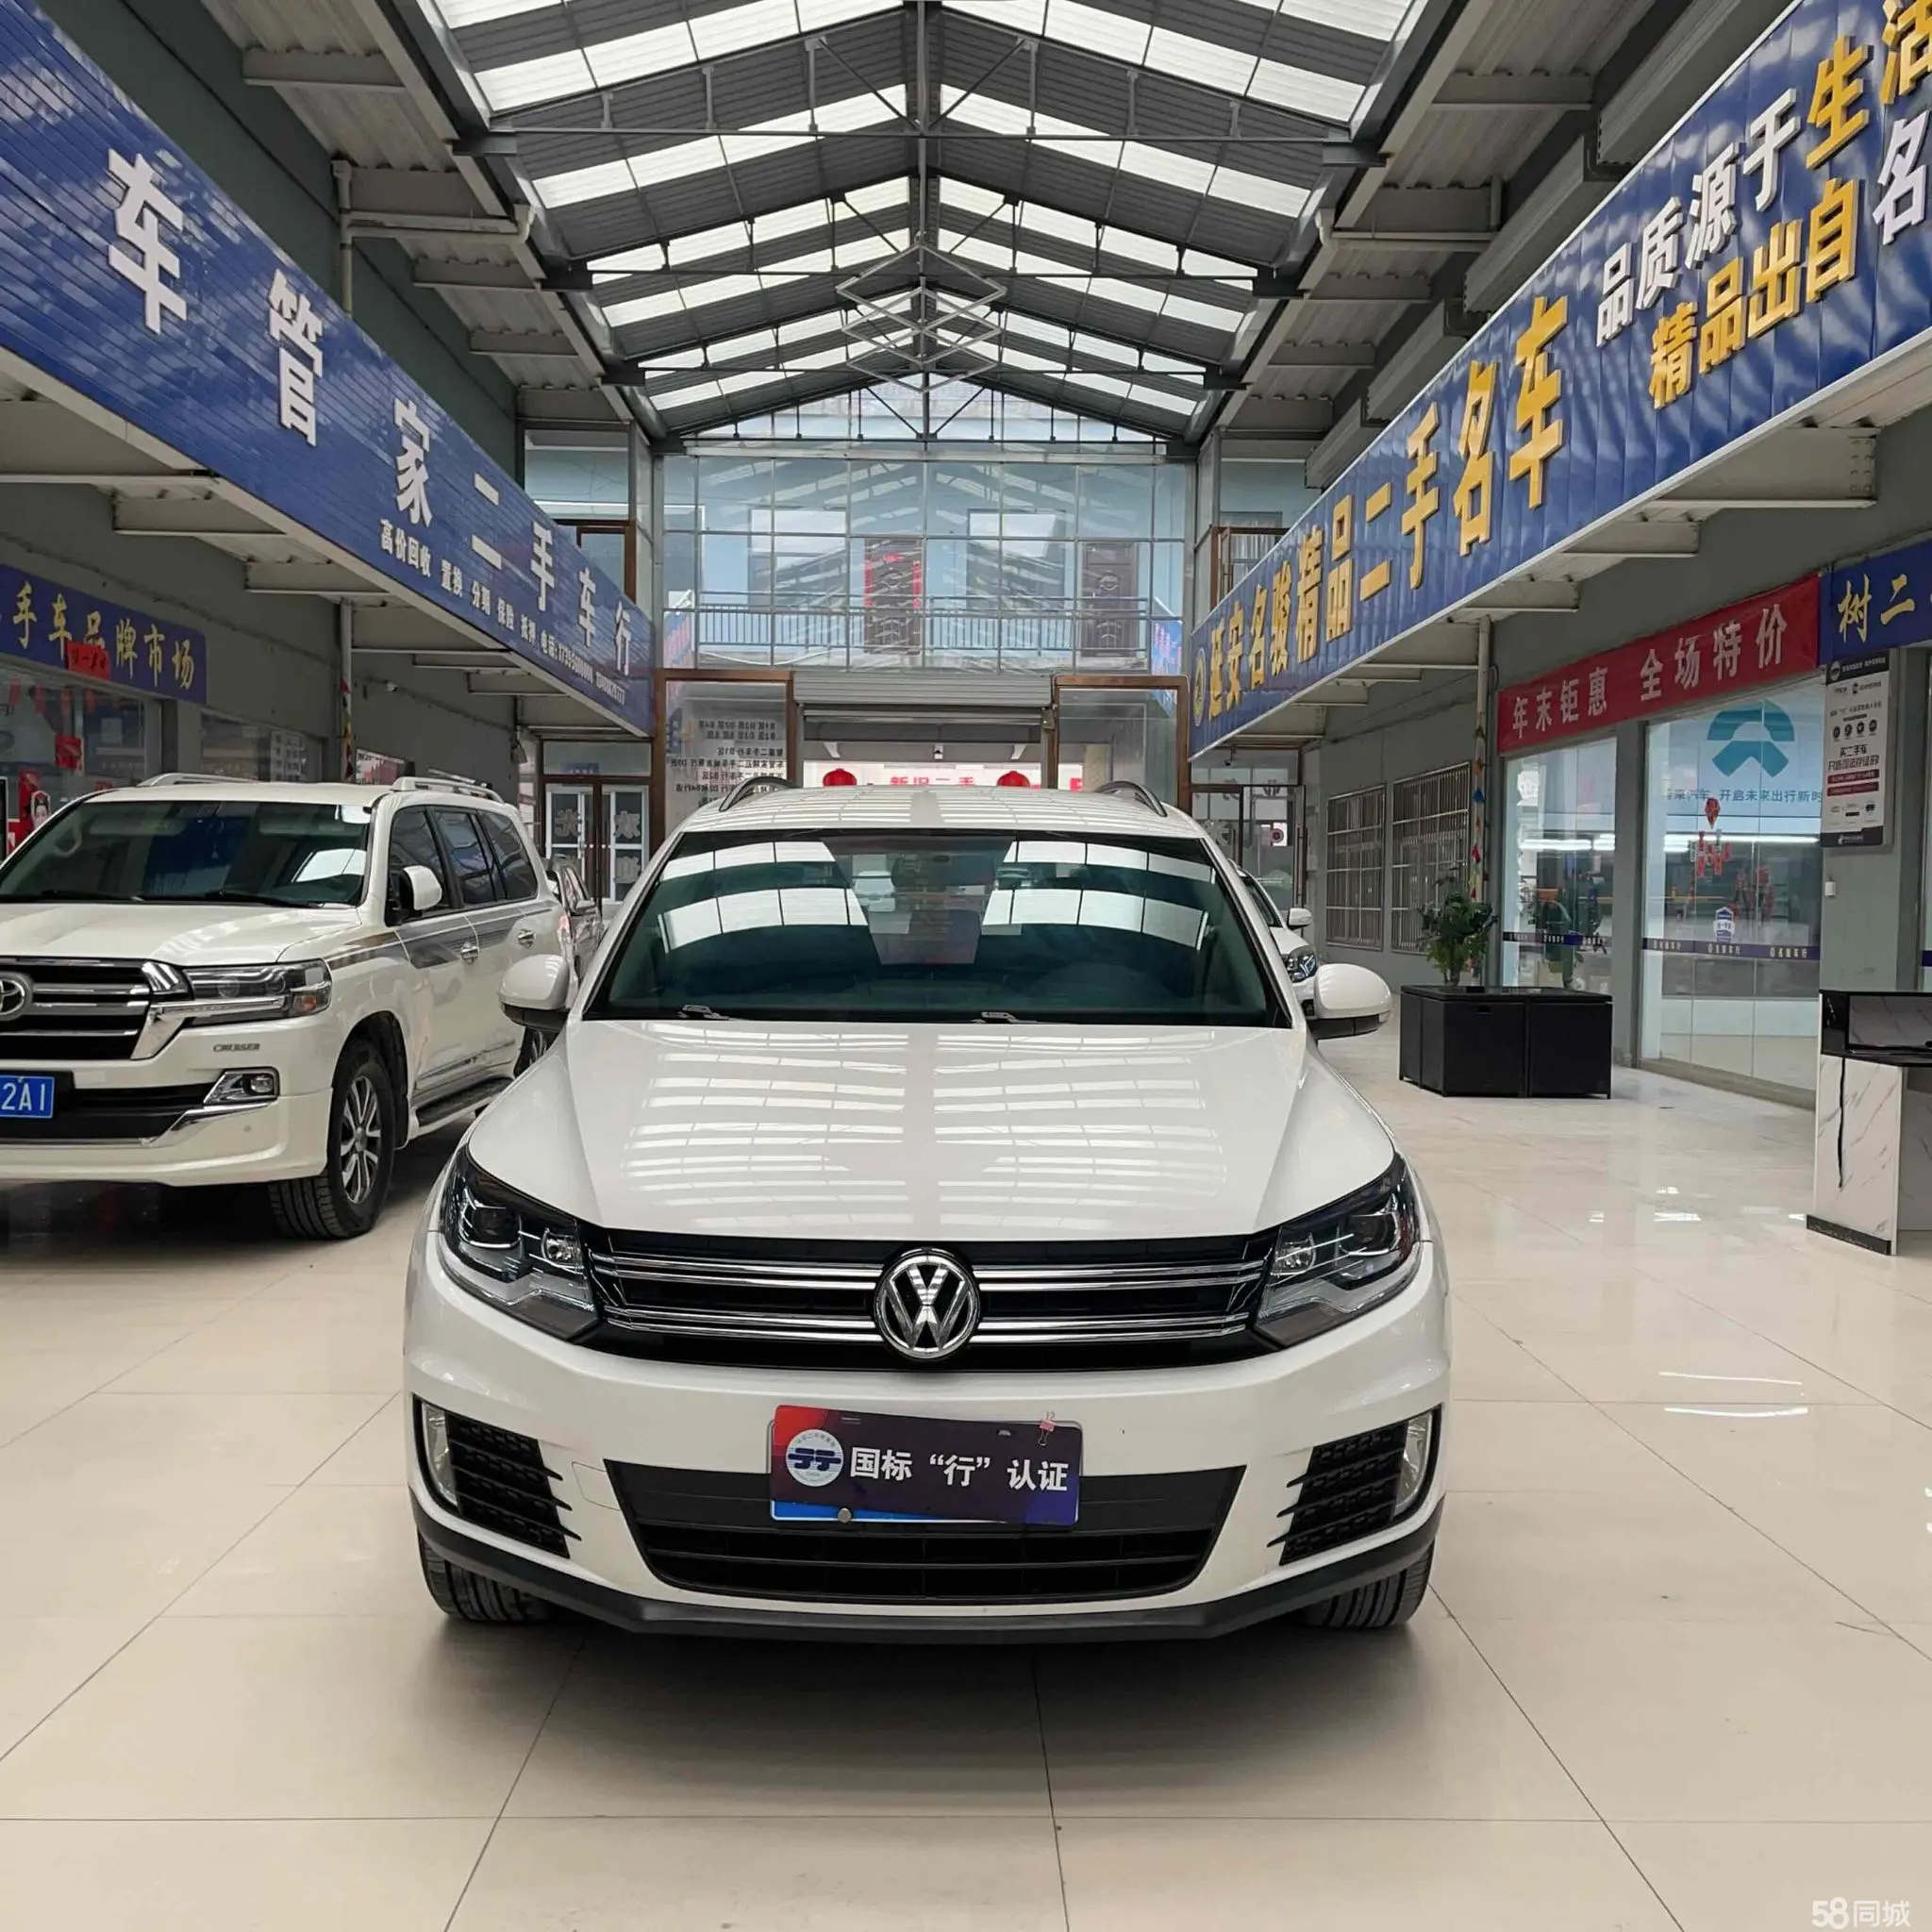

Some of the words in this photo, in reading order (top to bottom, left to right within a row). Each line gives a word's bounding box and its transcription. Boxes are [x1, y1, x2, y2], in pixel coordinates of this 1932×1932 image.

[1649, 110, 1931, 410] 精品出自名
[108, 147, 631, 676] 车管家二手车行
[380, 518, 431, 578] 高价回收
[441, 558, 463, 598] 置换
[1512, 665, 1608, 740] 年末钜惠
[1640, 603, 1789, 702] 全场特价
[1, 1082, 46, 1111] 2A1
[850, 1447, 913, 1481] 国标
[1007, 1460, 1069, 1491] 认证
